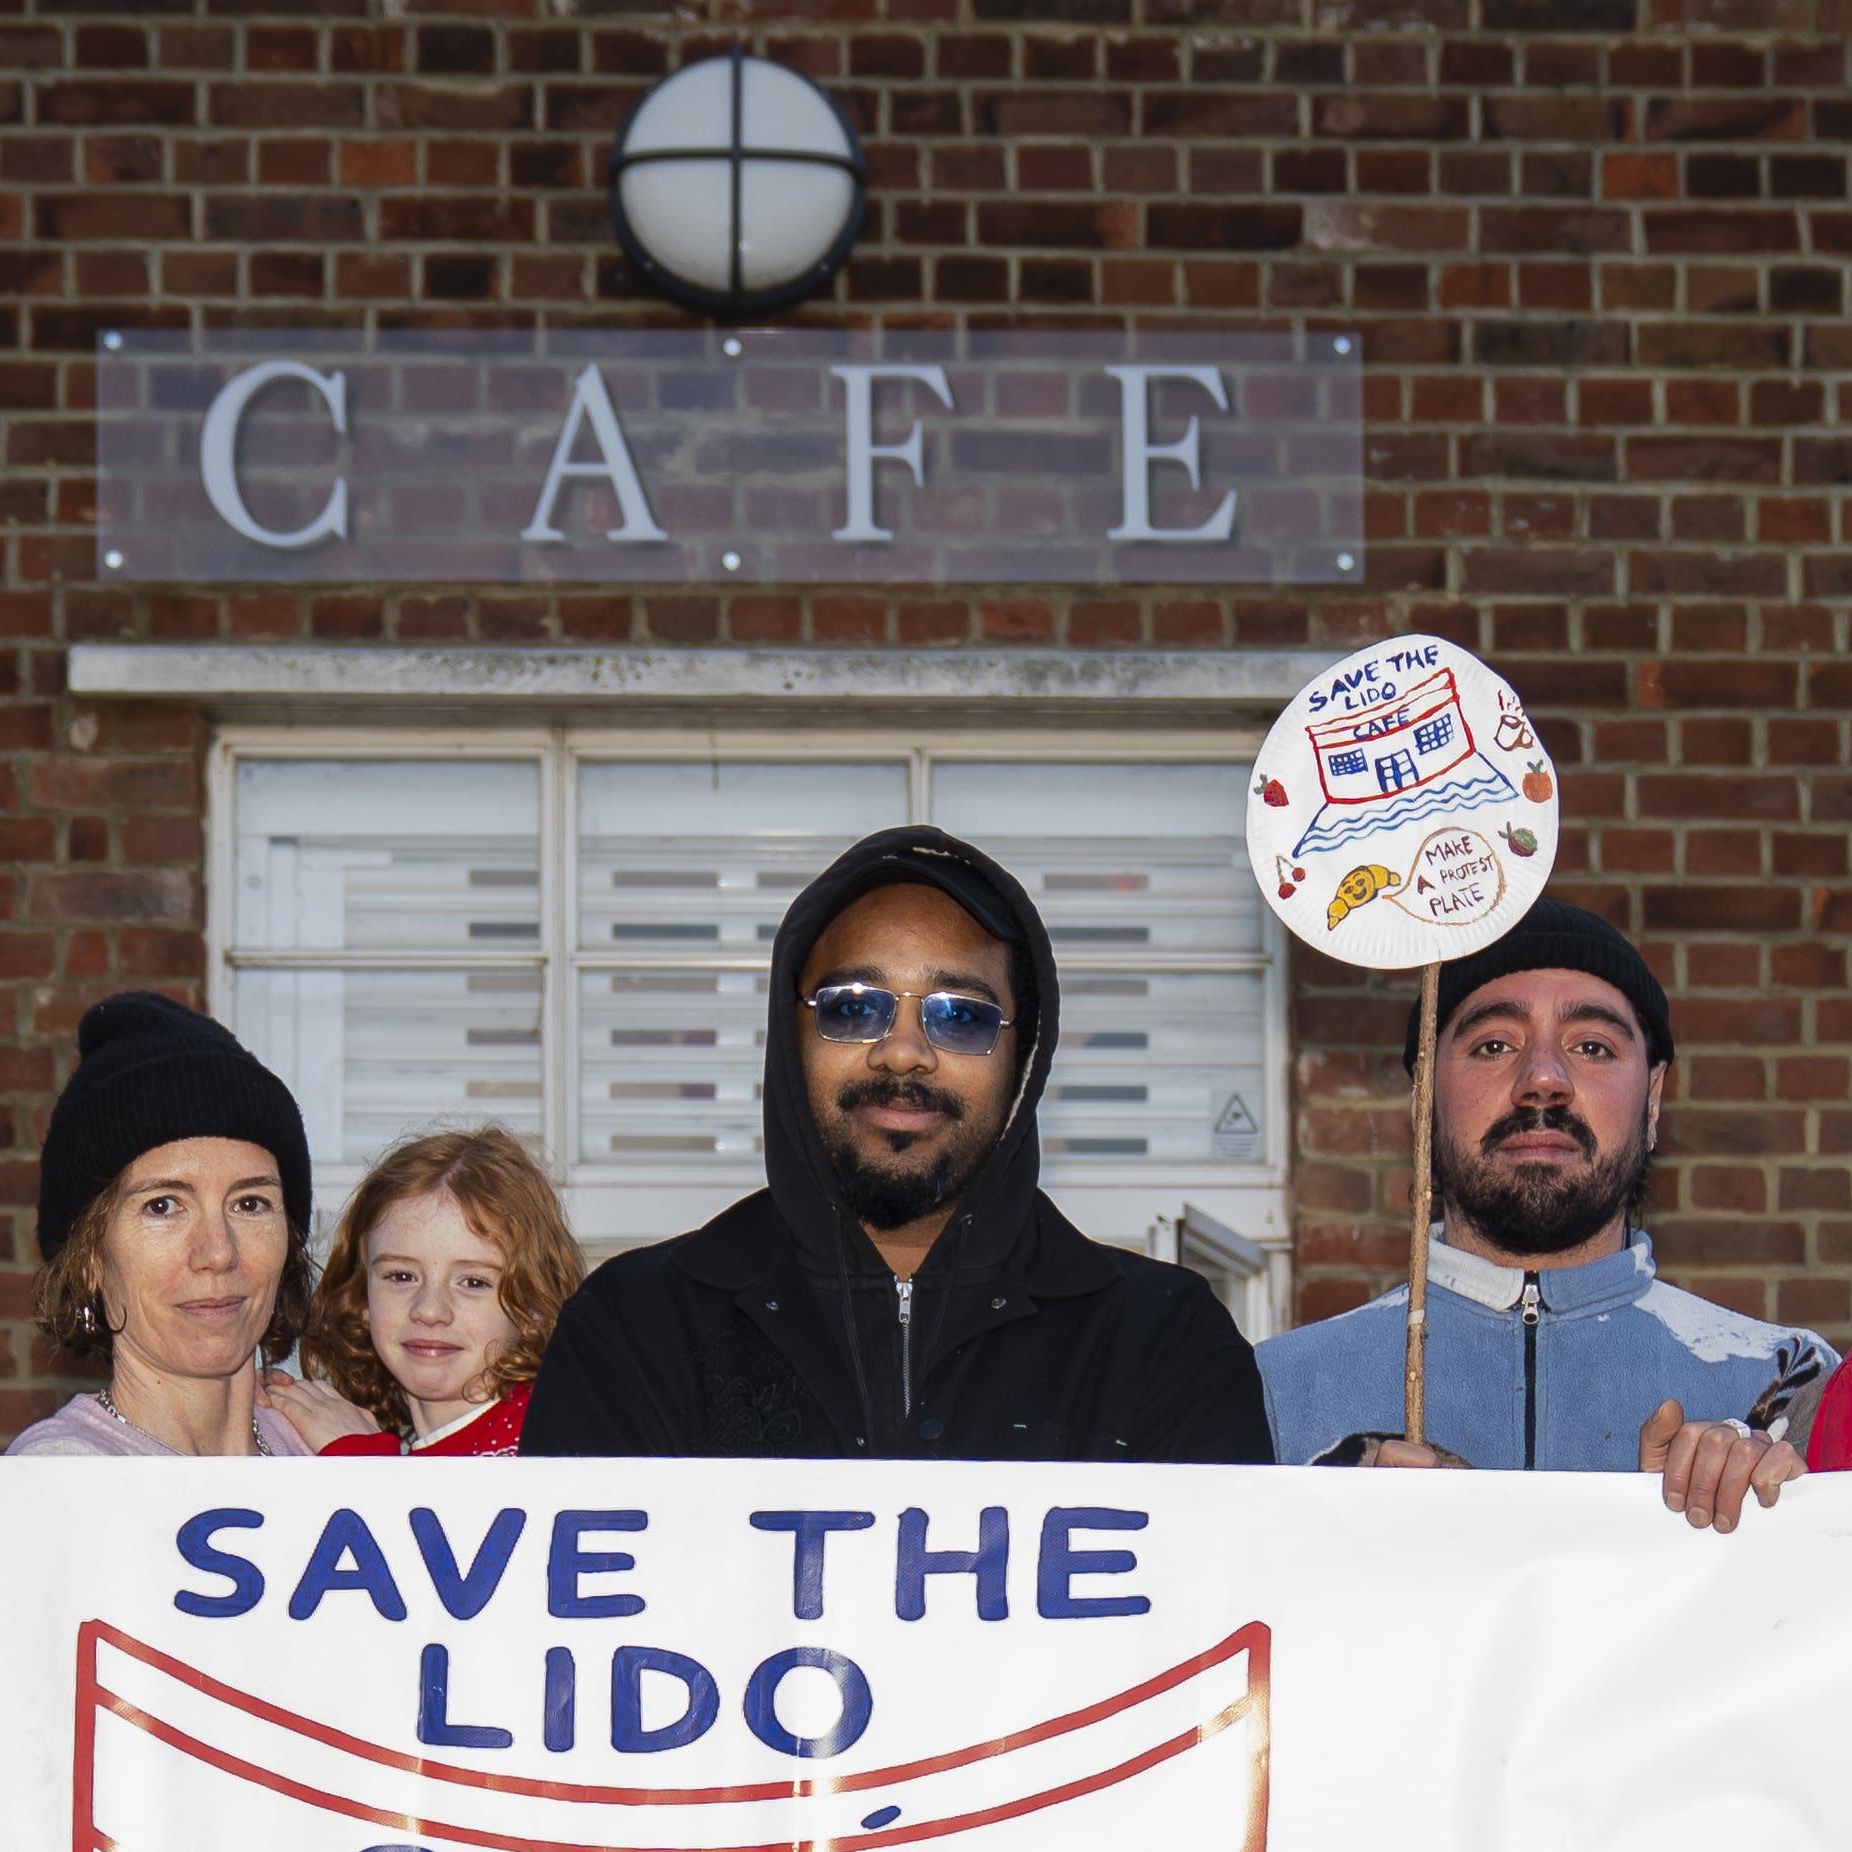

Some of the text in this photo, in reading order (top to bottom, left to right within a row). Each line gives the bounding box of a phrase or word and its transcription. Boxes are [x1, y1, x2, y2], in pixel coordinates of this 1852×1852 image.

[200, 360, 1237, 547] CAFE
[1308, 644, 1439, 713] SAVE THE
[1344, 682, 1396, 710] LIDO
[1417, 853, 1493, 895] A PROTEST
[1425, 835, 1473, 866] MAKE
[1429, 882, 1484, 916] PLATE
[174, 1507, 1152, 1621] SAVE THE
[417, 1643, 874, 1759] LIDO
